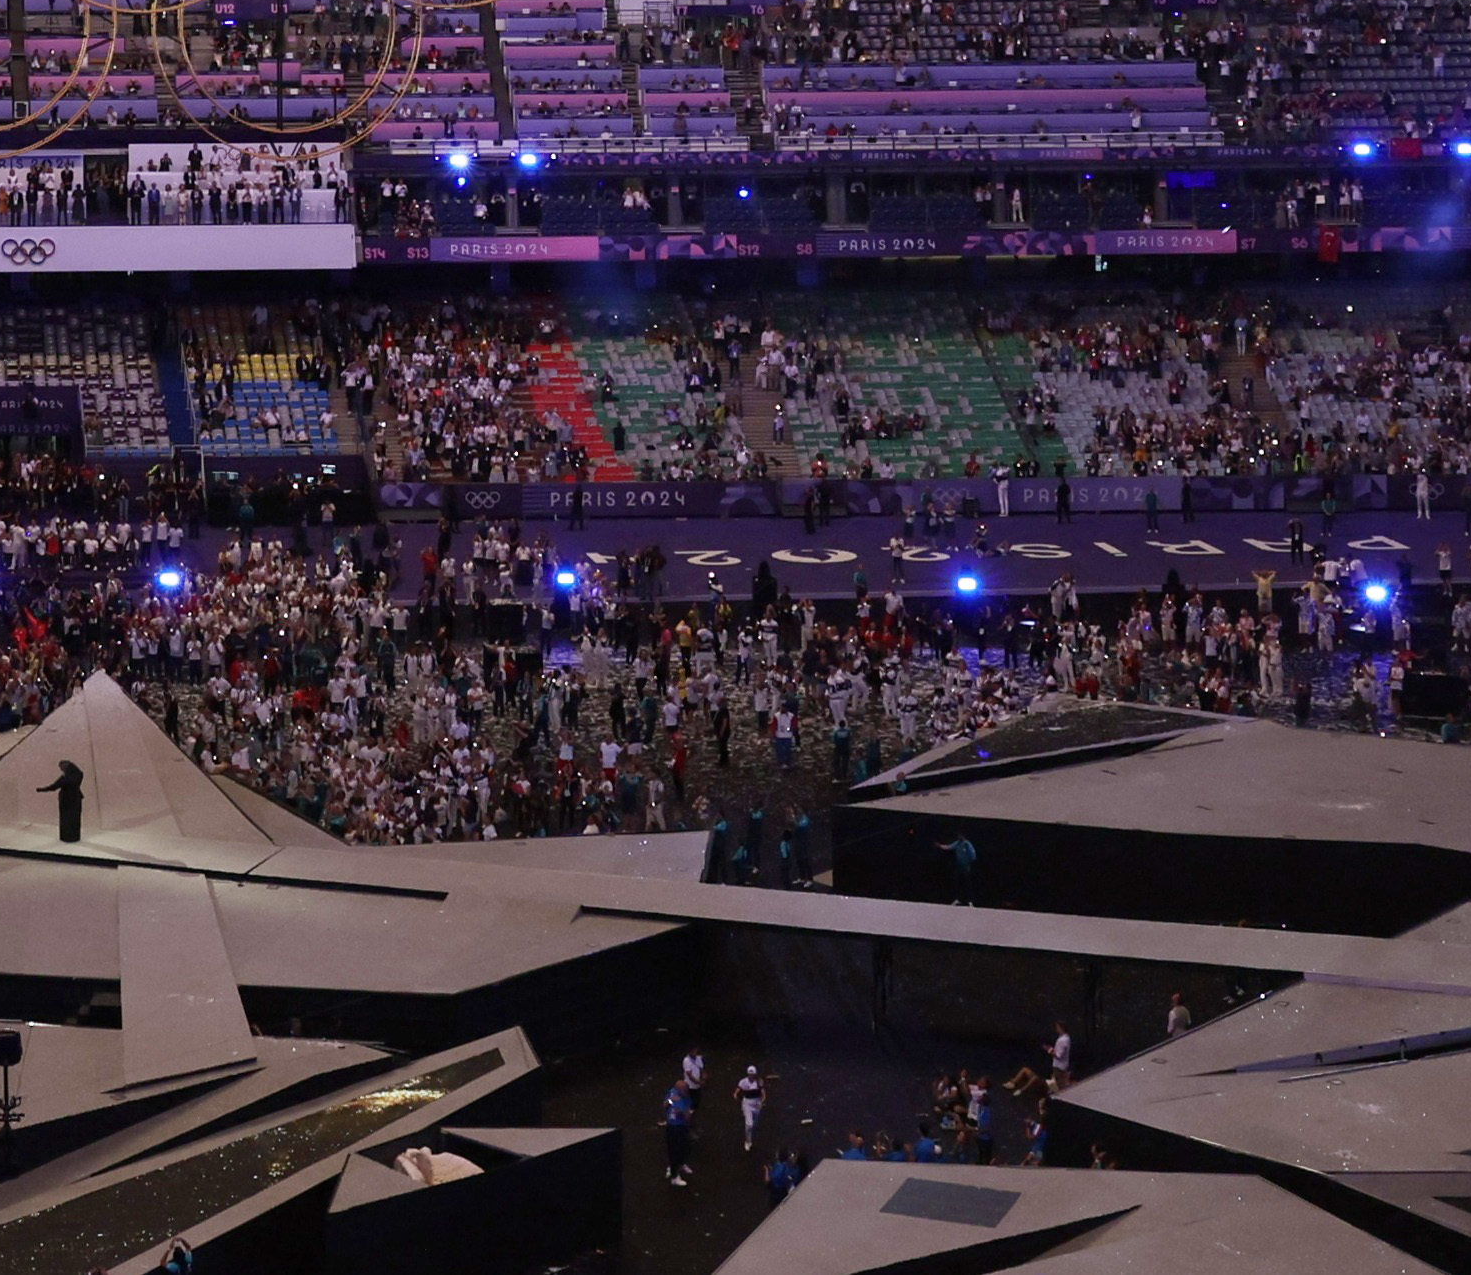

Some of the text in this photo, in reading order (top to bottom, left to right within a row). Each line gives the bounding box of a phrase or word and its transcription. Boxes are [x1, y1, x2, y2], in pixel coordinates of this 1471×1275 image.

[215, 4, 235, 14] U12
[271, 3, 288, 14] U1
[675, 5, 689, 16] T7
[750, 5, 764, 15] T6
[861, 152, 889, 160] PARIS
[1217, 148, 1244, 156] PARIS
[839, 238, 936, 252] PARIS 2024
[1117, 235, 1214, 249] PARIS 2024
[1241, 237, 1257, 250] S7
[1291, 236, 1309, 250] S6
[364, 247, 386, 260] S14
[407, 247, 429, 260] S13
[450, 243, 548, 257] PARIS 2024
[738, 243, 760, 256] S12
[796, 243, 814, 255] S8
[625, 490, 685, 507] 2024
[1023, 487, 1089, 504] PAIS
